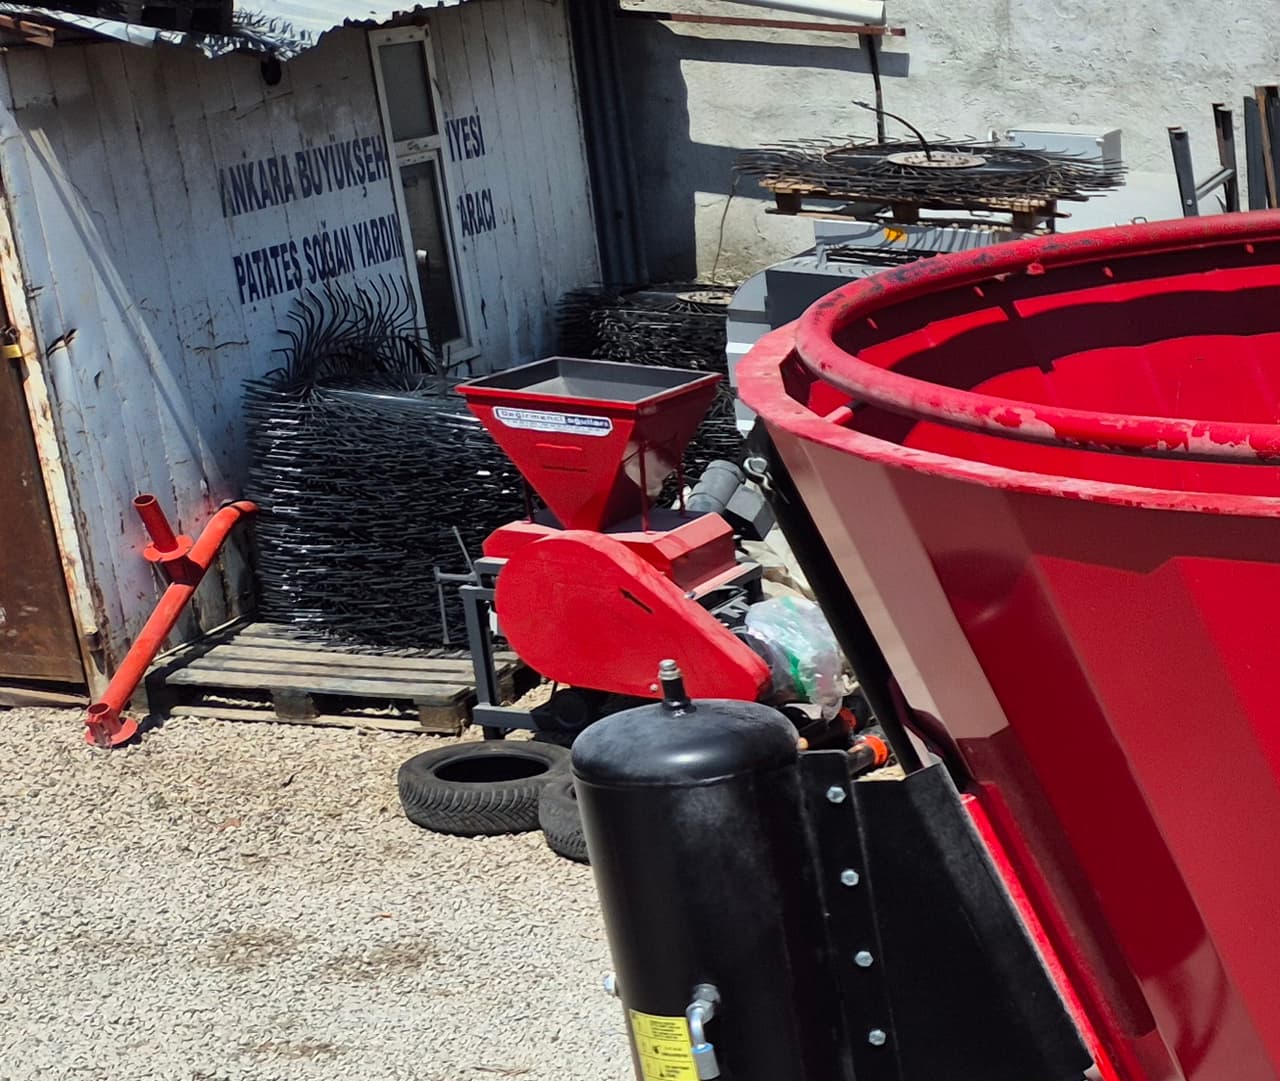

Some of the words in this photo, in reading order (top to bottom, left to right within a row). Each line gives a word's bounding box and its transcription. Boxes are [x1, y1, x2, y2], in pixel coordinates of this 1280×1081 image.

[219, 154, 297, 218] ANKARA
[444, 105, 486, 162] İYESİ
[233, 240, 303, 304] PATATES
[303, 220, 356, 284] SOĞAN
[458, 188, 497, 237] ARACI
